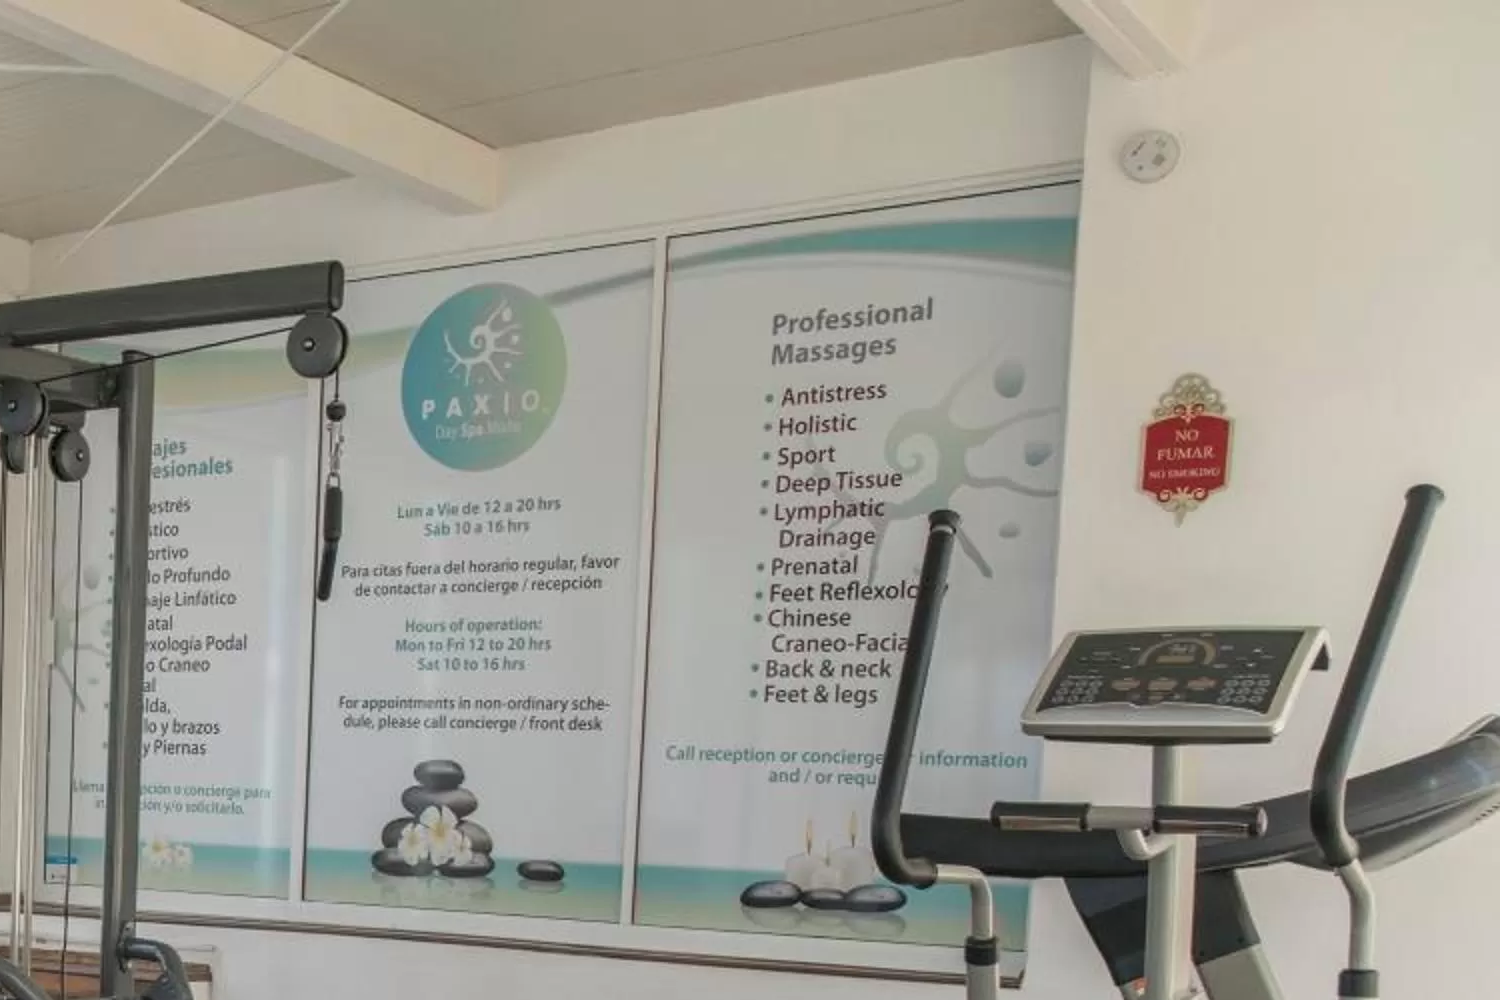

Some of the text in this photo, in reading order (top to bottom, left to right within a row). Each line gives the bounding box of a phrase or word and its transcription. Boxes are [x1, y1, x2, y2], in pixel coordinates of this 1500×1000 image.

[771, 296, 934, 336] Professional
[770, 337, 897, 366] Massages
[421, 389, 540, 420] PAXIO
[781, 383, 887, 406] Antistress
[779, 414, 857, 436] Holistic
[1175, 429, 1200, 442] NO
[153, 438, 188, 460] ajes
[777, 446, 836, 469] Sport
[1157, 446, 1216, 461] FUMAR
[153, 456, 234, 479] esionales
[775, 470, 903, 496] Deep Tissue
[150, 498, 191, 515] estrés
[397, 505, 423, 519] Lun
[462, 502, 480, 515] de
[484, 500, 501, 514] 12
[516, 498, 534, 512] 20
[774, 498, 885, 525] Lymphatic
[149, 522, 179, 537] stico
[455, 521, 471, 535] 10
[488, 520, 504, 534] 16
[779, 529, 876, 550] Drainage
[148, 545, 189, 561] ortivo
[164, 565, 231, 584] Profundo
[341, 553, 620, 578] Para citas fuera del horario regular, favor
[771, 556, 858, 576] Prenatal
[355, 583, 370, 597] de
[374, 580, 436, 596] contactar
[451, 576, 519, 597] concierge
[531, 573, 603, 594] recepción
[769, 580, 949, 603] Feet Reflexolo
[148, 615, 173, 631] atal
[405, 617, 542, 637] Hours of operation:
[768, 609, 852, 628] Chinese
[205, 633, 248, 651] Podal
[395, 636, 552, 653] Mon to Fri 12 to 20 hrs
[771, 632, 909, 653] Craneo-Facia
[417, 656, 526, 671] Sat 10 to 16 hrs
[765, 658, 892, 679] Back & neck
[339, 694, 610, 714] For appointments in non-ordinary sche-
[764, 684, 878, 708] Feet & legs
[173, 718, 220, 735] brazos
[343, 714, 375, 730] dule,
[378, 714, 421, 731] please
[423, 714, 447, 729] call
[450, 715, 517, 733] concierge
[529, 714, 564, 731] front
[568, 714, 602, 731] desk
[153, 739, 207, 756] Piernas
[666, 745, 695, 761] Call
[700, 748, 775, 764] reception
[779, 750, 798, 763] or
[801, 749, 884, 768] concierge
[920, 752, 1027, 769] information
[768, 768, 800, 783] and
[815, 771, 833, 784] or
[837, 771, 876, 788] requ
